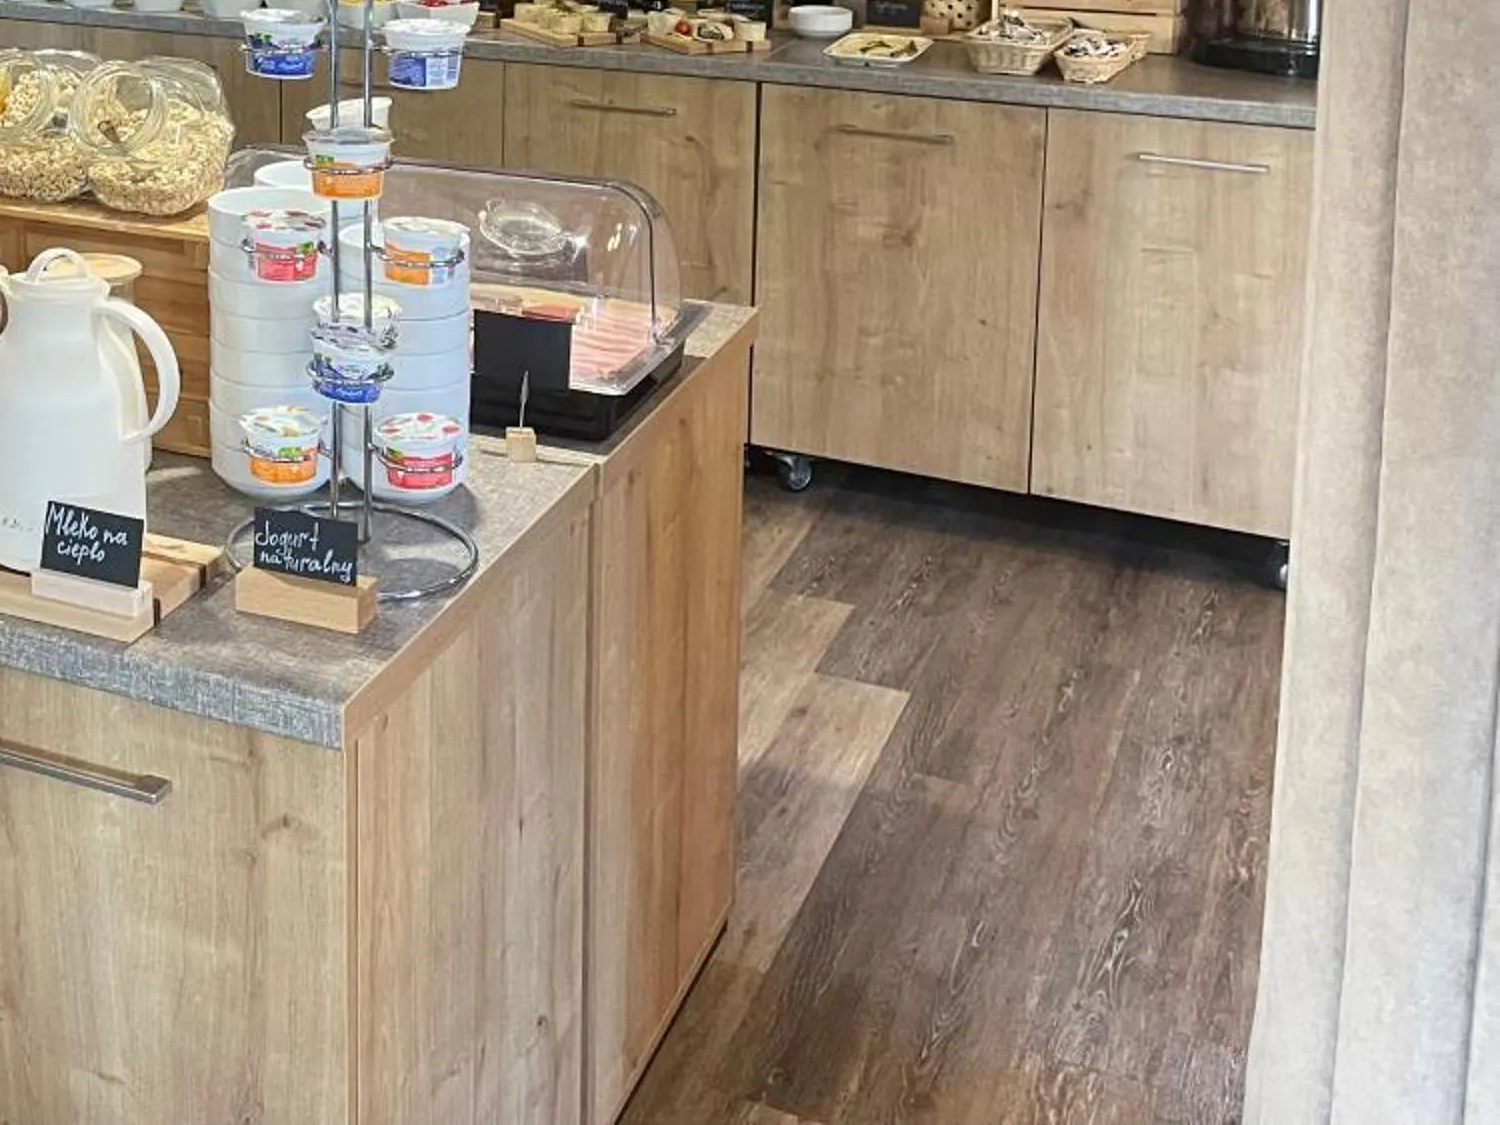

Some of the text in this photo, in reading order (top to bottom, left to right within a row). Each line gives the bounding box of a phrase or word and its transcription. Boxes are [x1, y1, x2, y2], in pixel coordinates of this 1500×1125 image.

[45, 503, 99, 540] Mleko
[103, 529, 129, 546] na
[255, 520, 320, 556] Jogurt
[260, 548, 353, 584] naturalny
